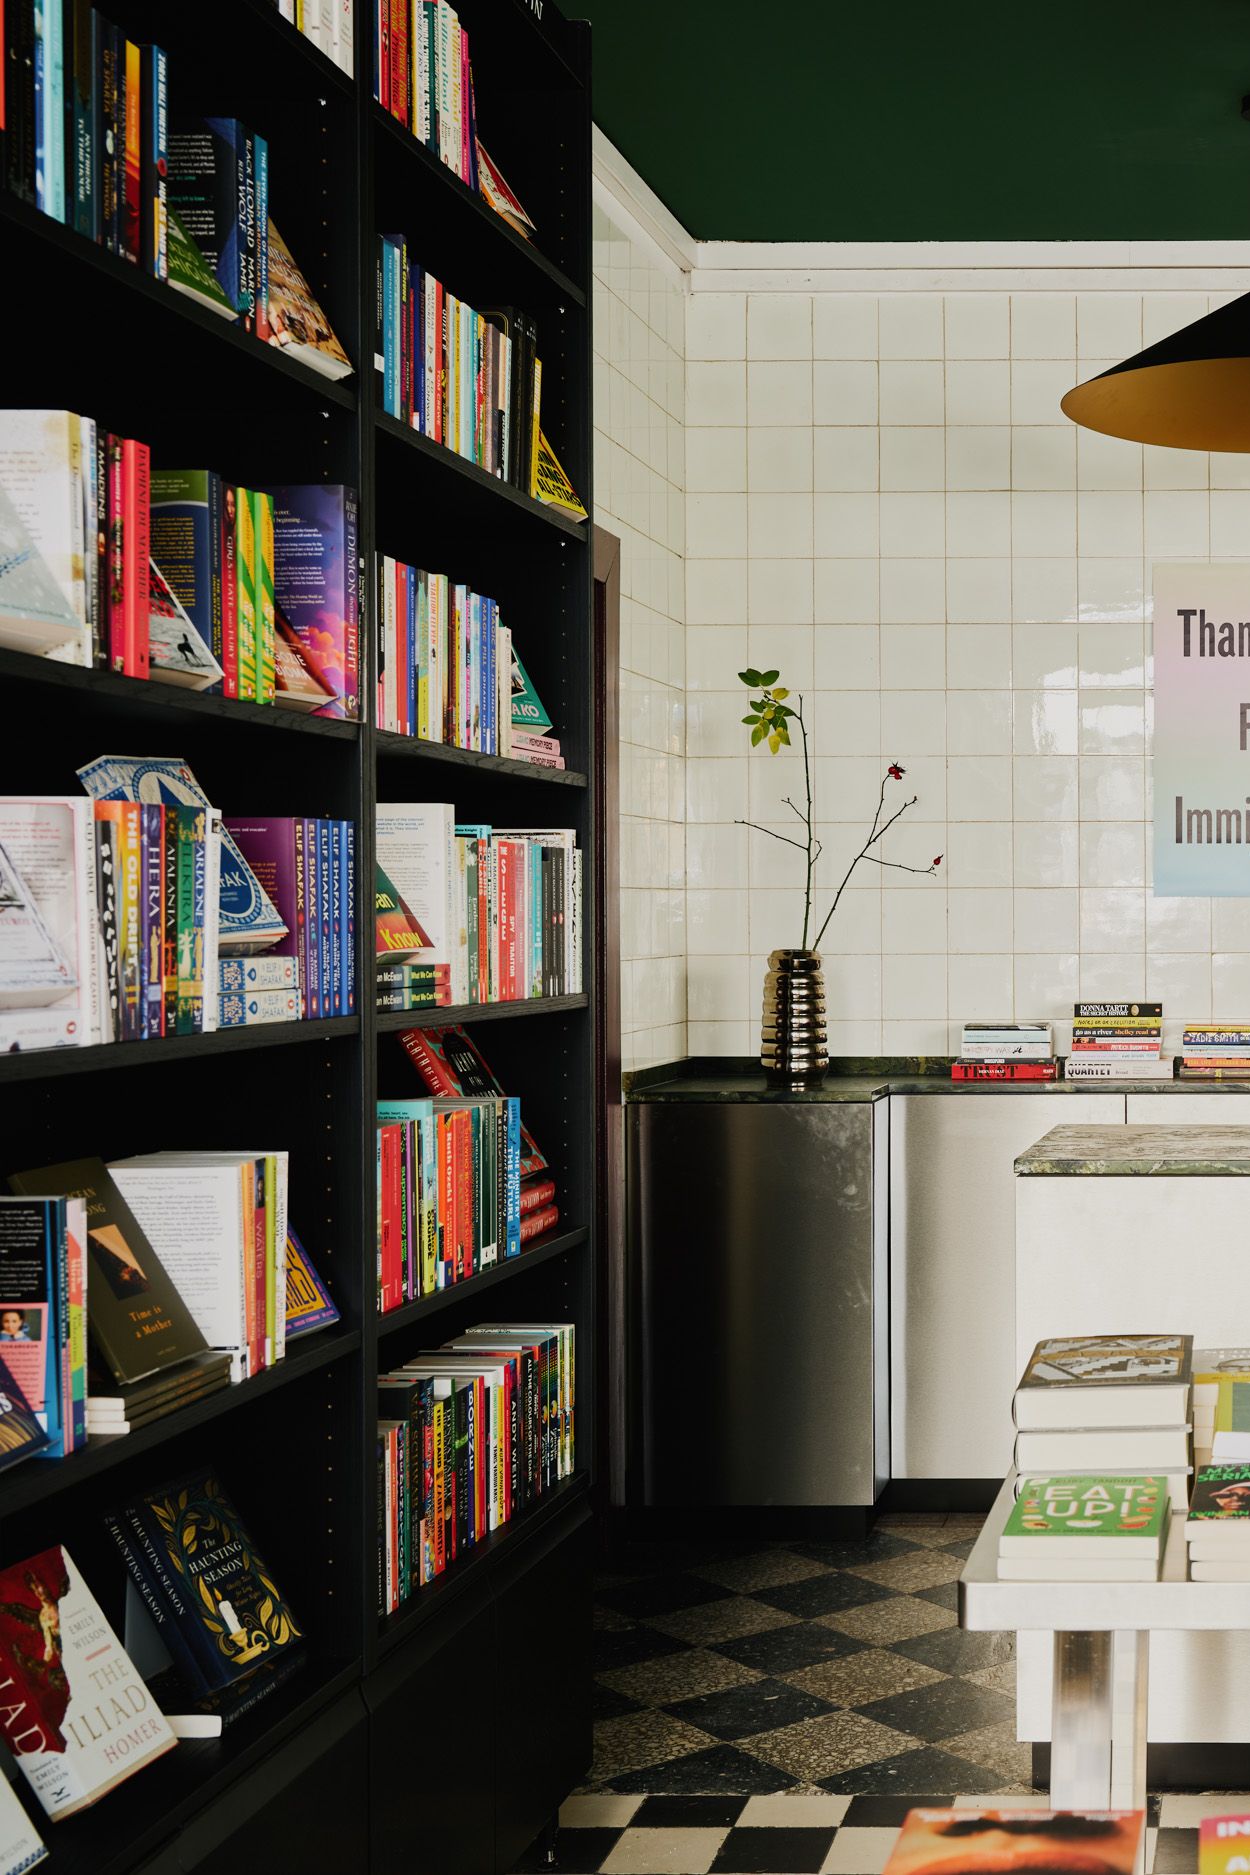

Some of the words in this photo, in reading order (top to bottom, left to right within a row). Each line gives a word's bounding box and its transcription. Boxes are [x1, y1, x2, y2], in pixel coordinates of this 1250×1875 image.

[441, 6, 449, 67] William
[441, 72, 449, 113] Boyd
[245, 139, 253, 176] BLACK
[238, 184, 247, 233] WOLF
[246, 178, 255, 249] LEOPARD
[97, 451, 106, 520] MAIDENS
[138, 448, 147, 509] DAPHNE
[138, 532, 147, 600] MAURIER
[347, 535, 356, 597] DEMON
[347, 625, 357, 673] LIGHT
[520, 704, 540, 718] KO
[127, 811, 138, 842] THE
[295, 825, 303, 852] ELIF
[127, 856, 138, 892] OLD
[148, 846, 161, 918] HERA
[296, 854, 304, 910] SHAFAK
[309, 855, 317, 918] SHAFAK
[127, 905, 139, 964] DRIFT
[379, 928, 424, 950] Know
[383, 971, 403, 982] McEwan
[1080, 1004, 1104, 1012] DONNA
[1104, 1004, 1129, 1012] TARTT
[1214, 1032, 1240, 1043] SMITH
[401, 1033, 428, 1069] DEATH
[429, 1073, 442, 1091] THE
[961, 1065, 1018, 1078] TRUST
[128, 1309, 152, 1323] Time
[144, 1318, 174, 1335] Mother
[1043, 1484, 1147, 1500] EAT
[1045, 1500, 1130, 1518] UP!
[188, 1540, 243, 1575] HAUNTING
[202, 1538, 216, 1550] The
[110, 1525, 143, 1581] HAUNTING
[139, 1580, 167, 1625] SEASON
[203, 1556, 245, 1586] SEASON
[67, 1614, 95, 1637] EMILY
[71, 1626, 107, 1650] WILSON
[89, 1657, 130, 1692] THE
[67, 1683, 147, 1750] ILIAD
[103, 1717, 162, 1765] HOMER
